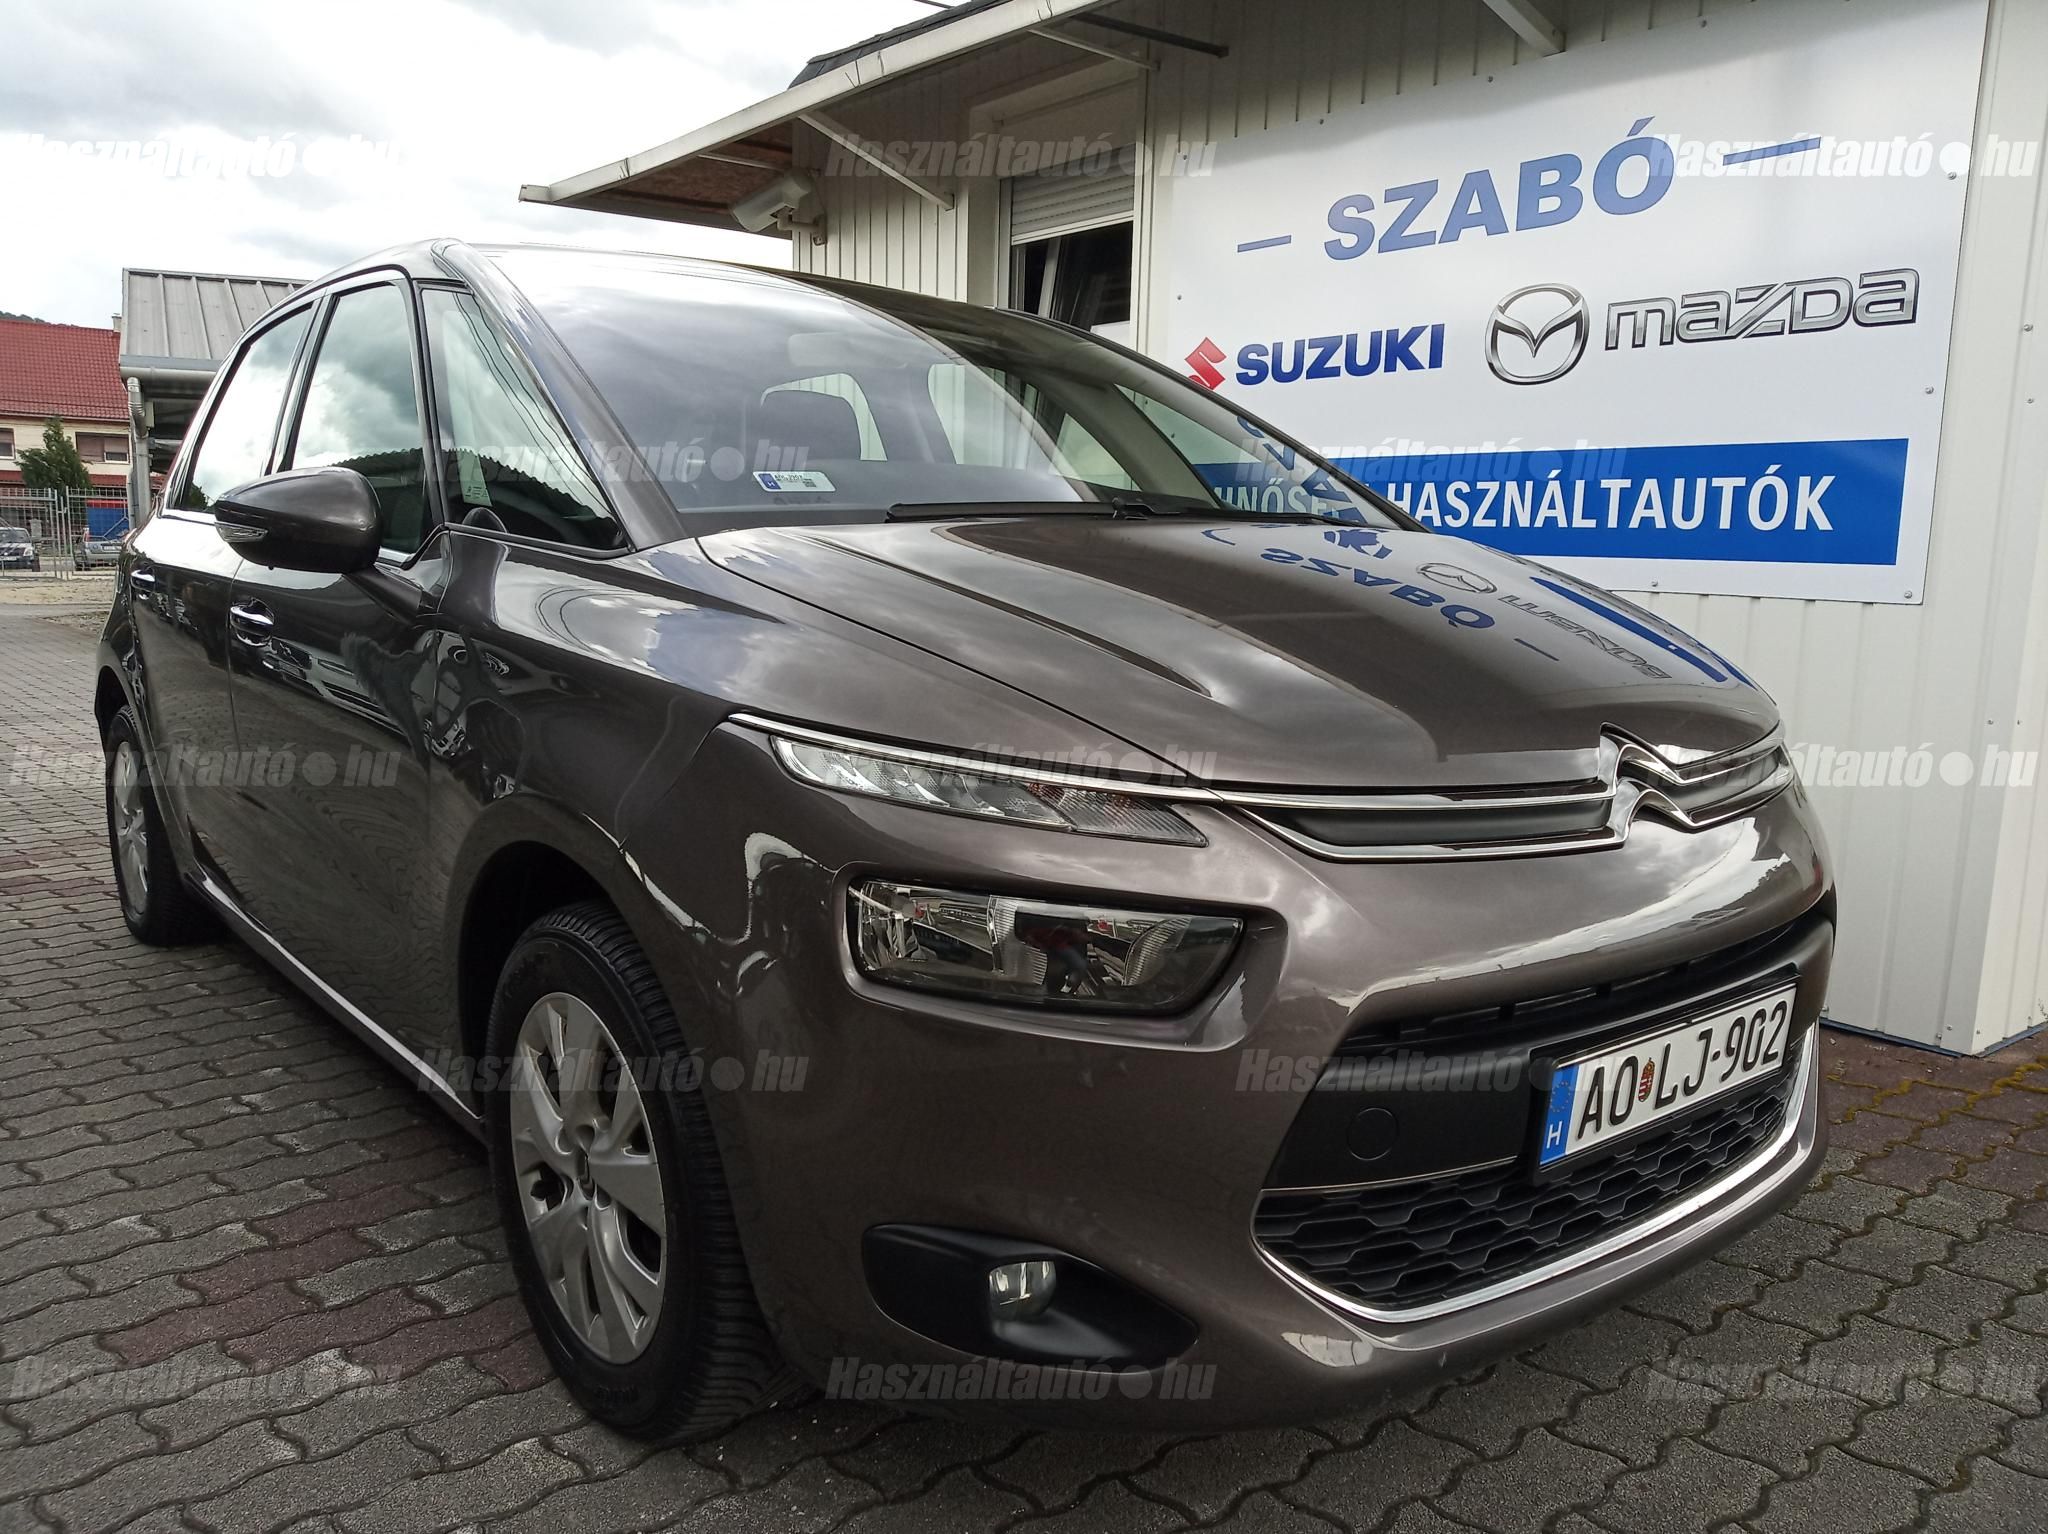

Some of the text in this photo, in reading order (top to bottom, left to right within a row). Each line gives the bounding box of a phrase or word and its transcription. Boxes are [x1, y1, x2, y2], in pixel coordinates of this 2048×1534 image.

[1324, 116, 1674, 260] SZABÓ
[1235, 323, 1445, 385] SUZUKI
[1387, 464, 1835, 531] HASZNÁLTAUTÓK
[1546, 1120, 1563, 1149] H
